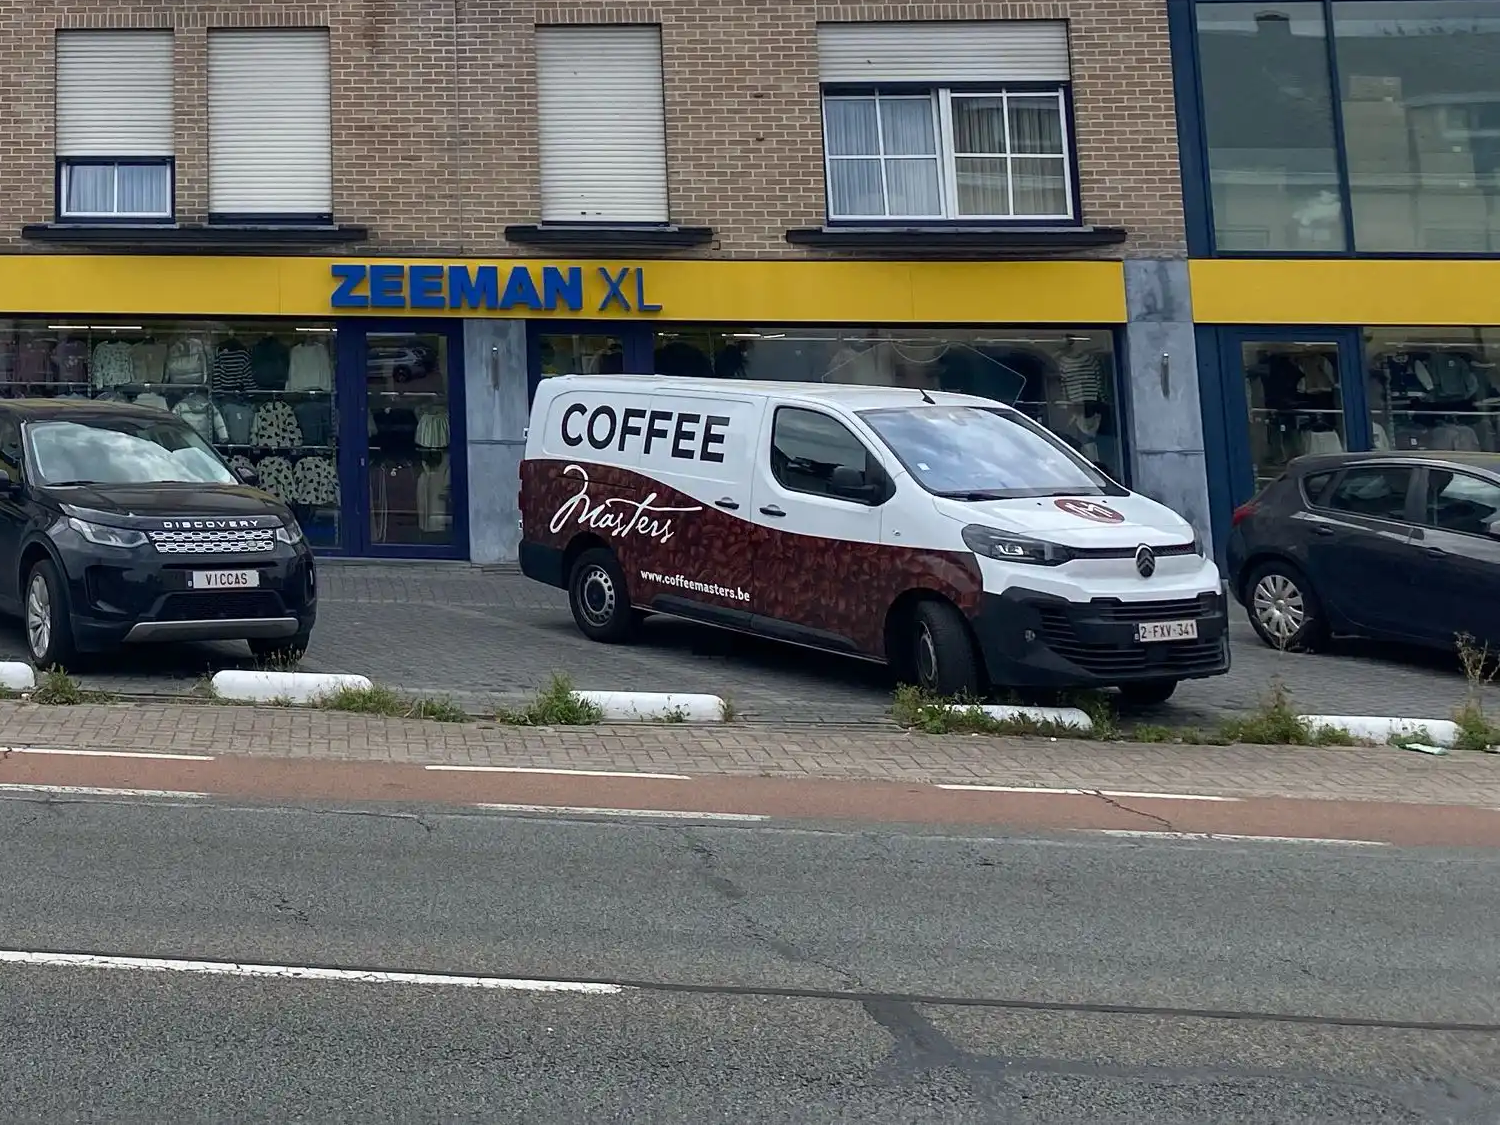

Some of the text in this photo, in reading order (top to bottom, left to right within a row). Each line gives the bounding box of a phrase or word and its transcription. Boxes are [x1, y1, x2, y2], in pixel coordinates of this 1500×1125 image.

[330, 264, 663, 312] ZEEMAN XL
[561, 402, 730, 463] COFFEE
[550, 464, 703, 544] Masters
[163, 520, 259, 529] DISCOVERY
[205, 573, 248, 586] VICCAS
[640, 569, 751, 602] www.coffeemasters.be
[1140, 623, 1196, 639] 2-FXV-341
